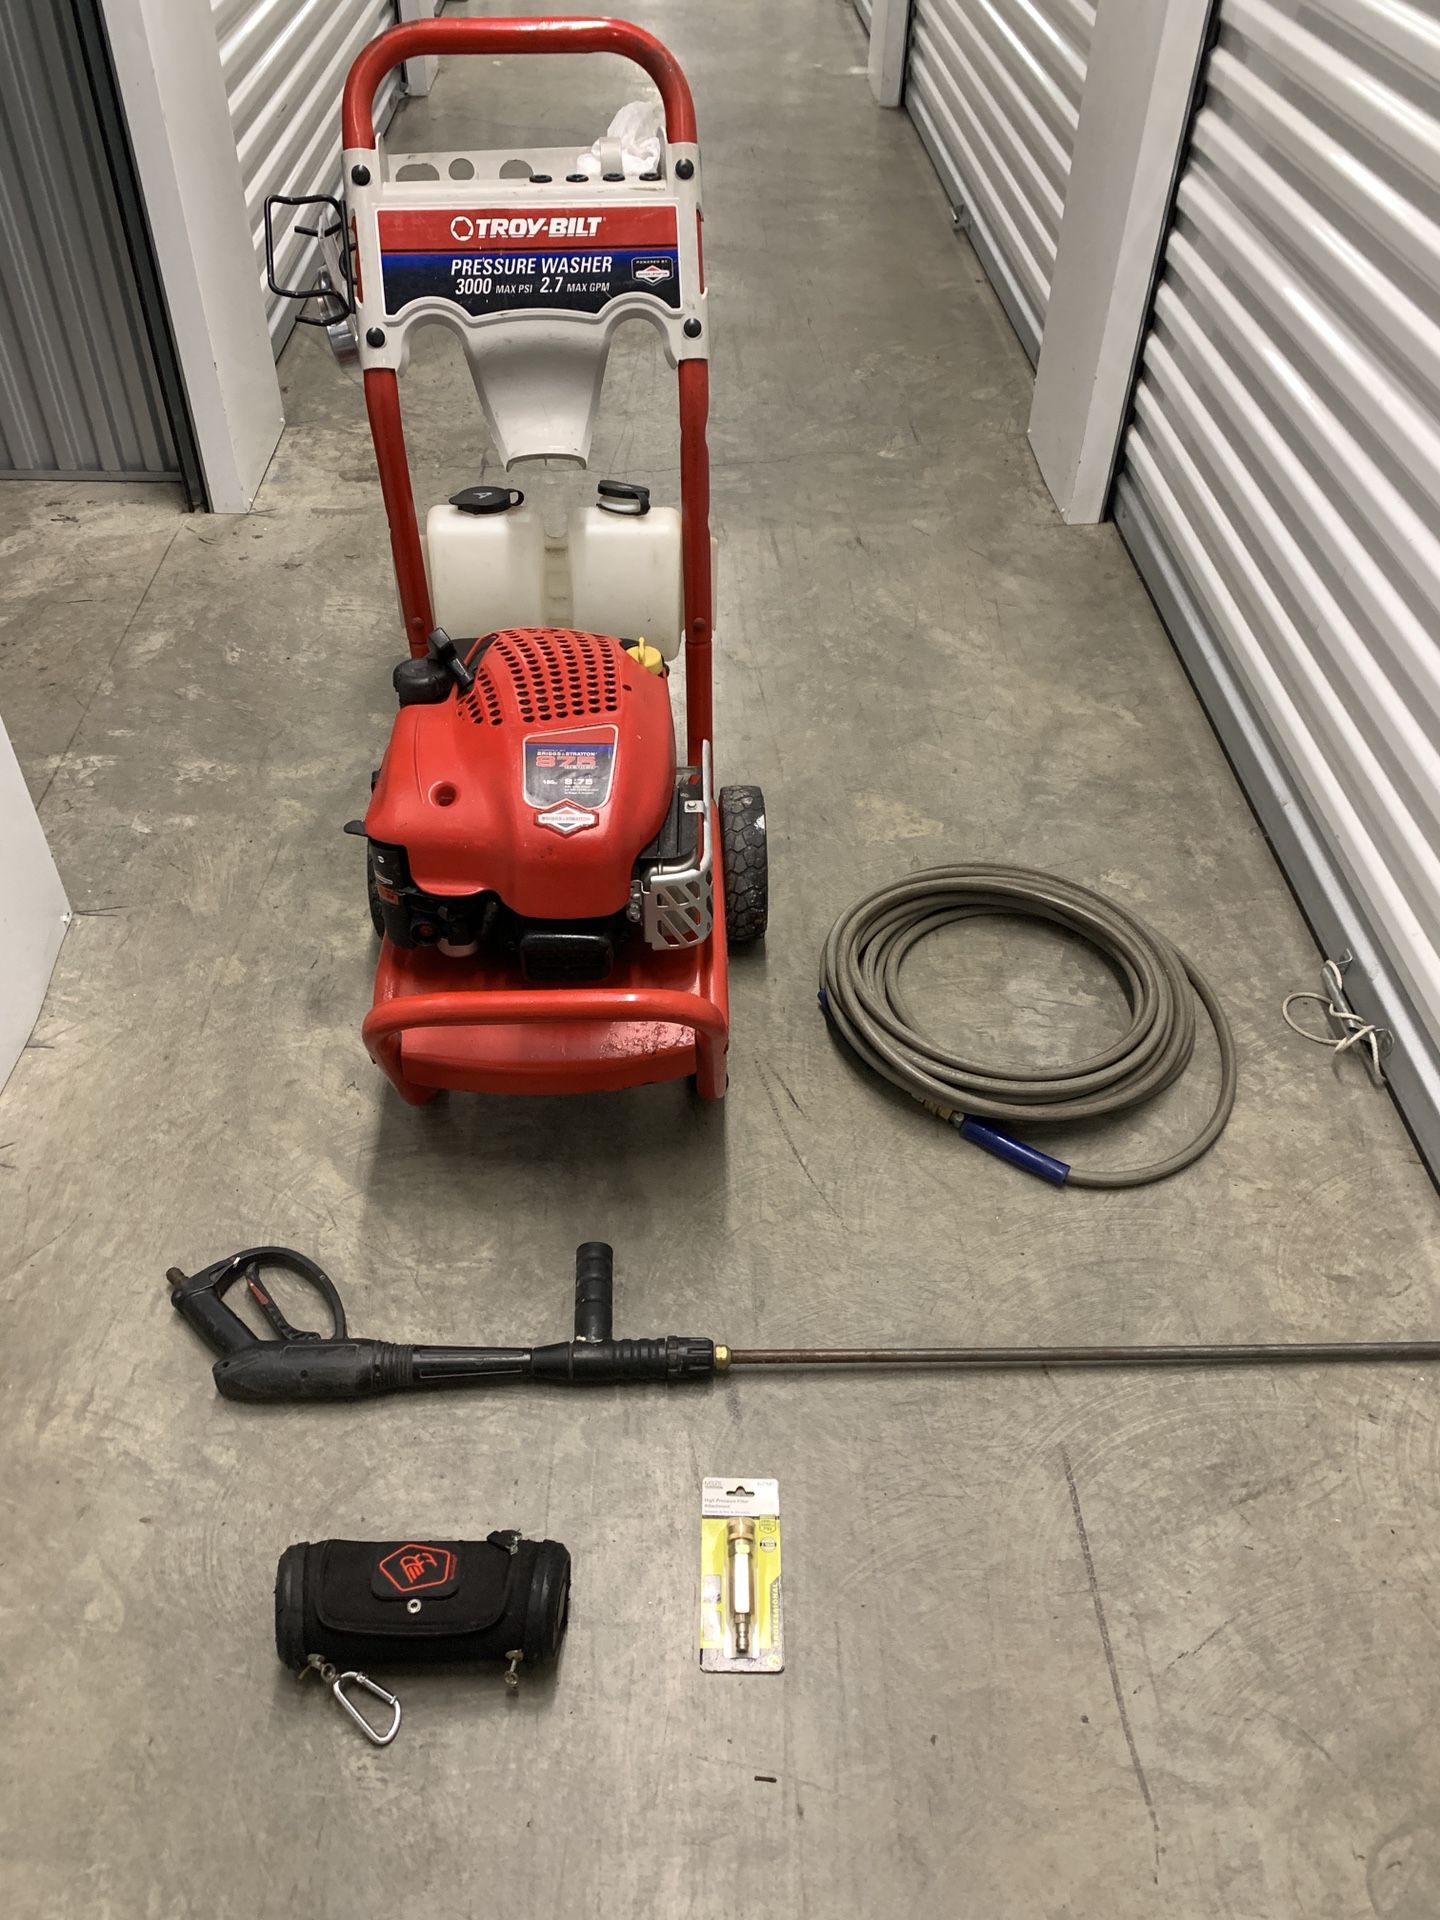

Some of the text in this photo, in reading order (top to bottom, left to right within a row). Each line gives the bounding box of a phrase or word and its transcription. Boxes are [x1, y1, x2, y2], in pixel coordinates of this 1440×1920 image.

[476, 217, 602, 238] TROY-BILT
[451, 256, 612, 276] PRESSURE WASHER
[455, 277, 610, 295] 3000 MAX PSI 2.7 MAX GPM
[535, 755, 596, 768] 875
